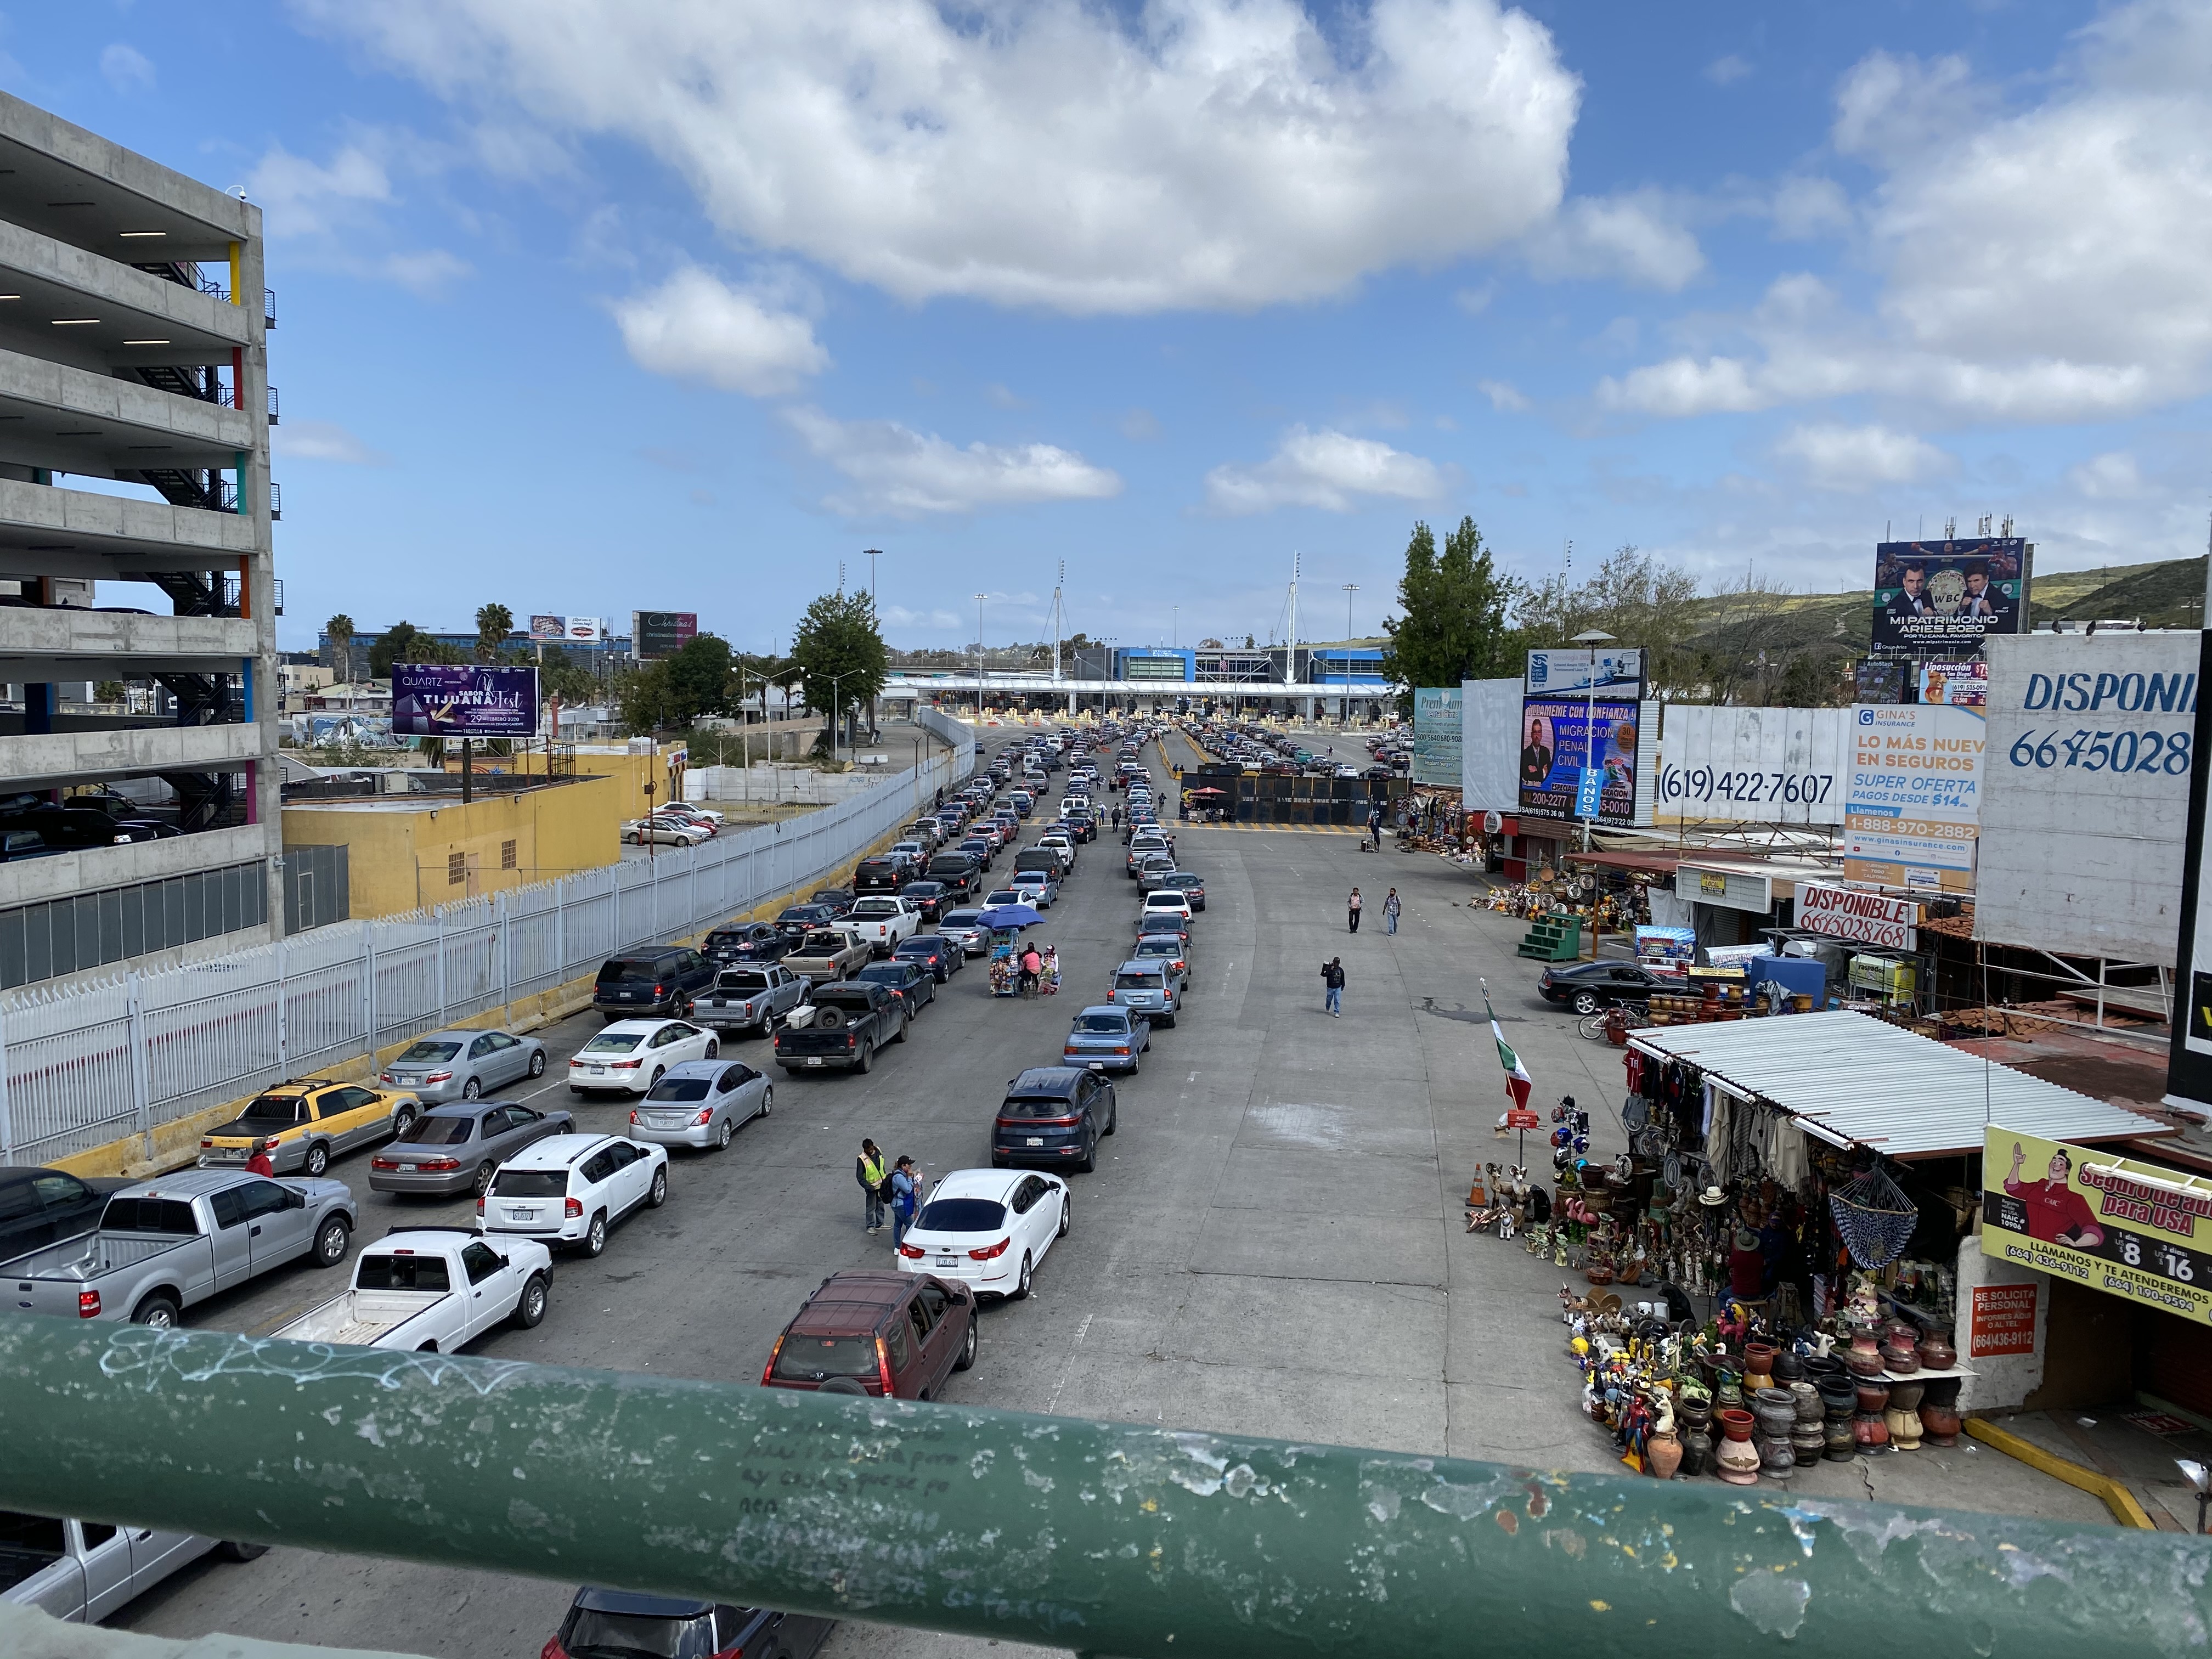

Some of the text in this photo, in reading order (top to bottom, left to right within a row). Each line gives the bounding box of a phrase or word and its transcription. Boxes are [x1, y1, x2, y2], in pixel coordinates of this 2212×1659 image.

[1935, 594, 1960, 603] WBC
[648, 613, 693, 628] Christina's
[1890, 616, 1999, 625] MI PATRIMONIO
[1898, 625, 1985, 634] ARIES 2020
[1925, 662, 1971, 673] Liposucción
[402, 676, 442, 686] QUARTZ
[2024, 672, 2197, 713] DISPONI
[424, 695, 493, 705] TIJUANA
[470, 714, 482, 723] 29
[1569, 706, 1585, 718] CON
[1586, 707, 1628, 720] CONFIANZA
[1876, 710, 1916, 720] GINA'S
[1559, 725, 1615, 738] MIGRACION
[1622, 727, 1631, 735] 30
[1559, 740, 1588, 752] PENAL
[1858, 735, 1881, 748] LO
[1887, 733, 1927, 751] MÁS
[1558, 754, 1581, 768] CIVIL
[1857, 753, 1974, 771] EN SEGUROS
[1854, 774, 1976, 794] SUPER OFERTA
[1532, 793, 1567, 807] 200-2277
[1852, 791, 1889, 801] PAGOS
[1892, 793, 1929, 804] DESDE
[1851, 805, 1894, 817] Llamenos
[1851, 817, 1975, 840] 1-888-970-2882
[1854, 835, 1965, 851] www.ginasinsurance.com
[1804, 887, 1909, 924] DISPONIBLE
[1714, 953, 1753, 964] CLAMATOS
[1858, 964, 1885, 974] raspados
[2044, 1198, 2061, 1207] CAIC
[2181, 1195, 2212, 1220] au
[2001, 1213, 2018, 1223] NAIC
[2102, 1193, 2194, 1238] para USA
[2001, 1219, 2022, 1230] 10906
[2115, 1238, 2125, 1246] US
[2124, 1243, 2141, 1266] 8
[2154, 1250, 2164, 1259] US
[2165, 1254, 2194, 1282] 16
[2005, 1244, 2195, 1312] (664) 436-9112 (664) 190-9594
[2030, 1242, 2091, 1267] LLÁMANOS
[2105, 1264, 2117, 1276] TE
[2120, 1269, 2209, 1304] ATENDEREMOS
[1975, 1290, 2036, 1302] SE SOLICITA
[1978, 1300, 2031, 1311] PERSONAL
[1976, 1313, 2012, 1322] INFORMES
